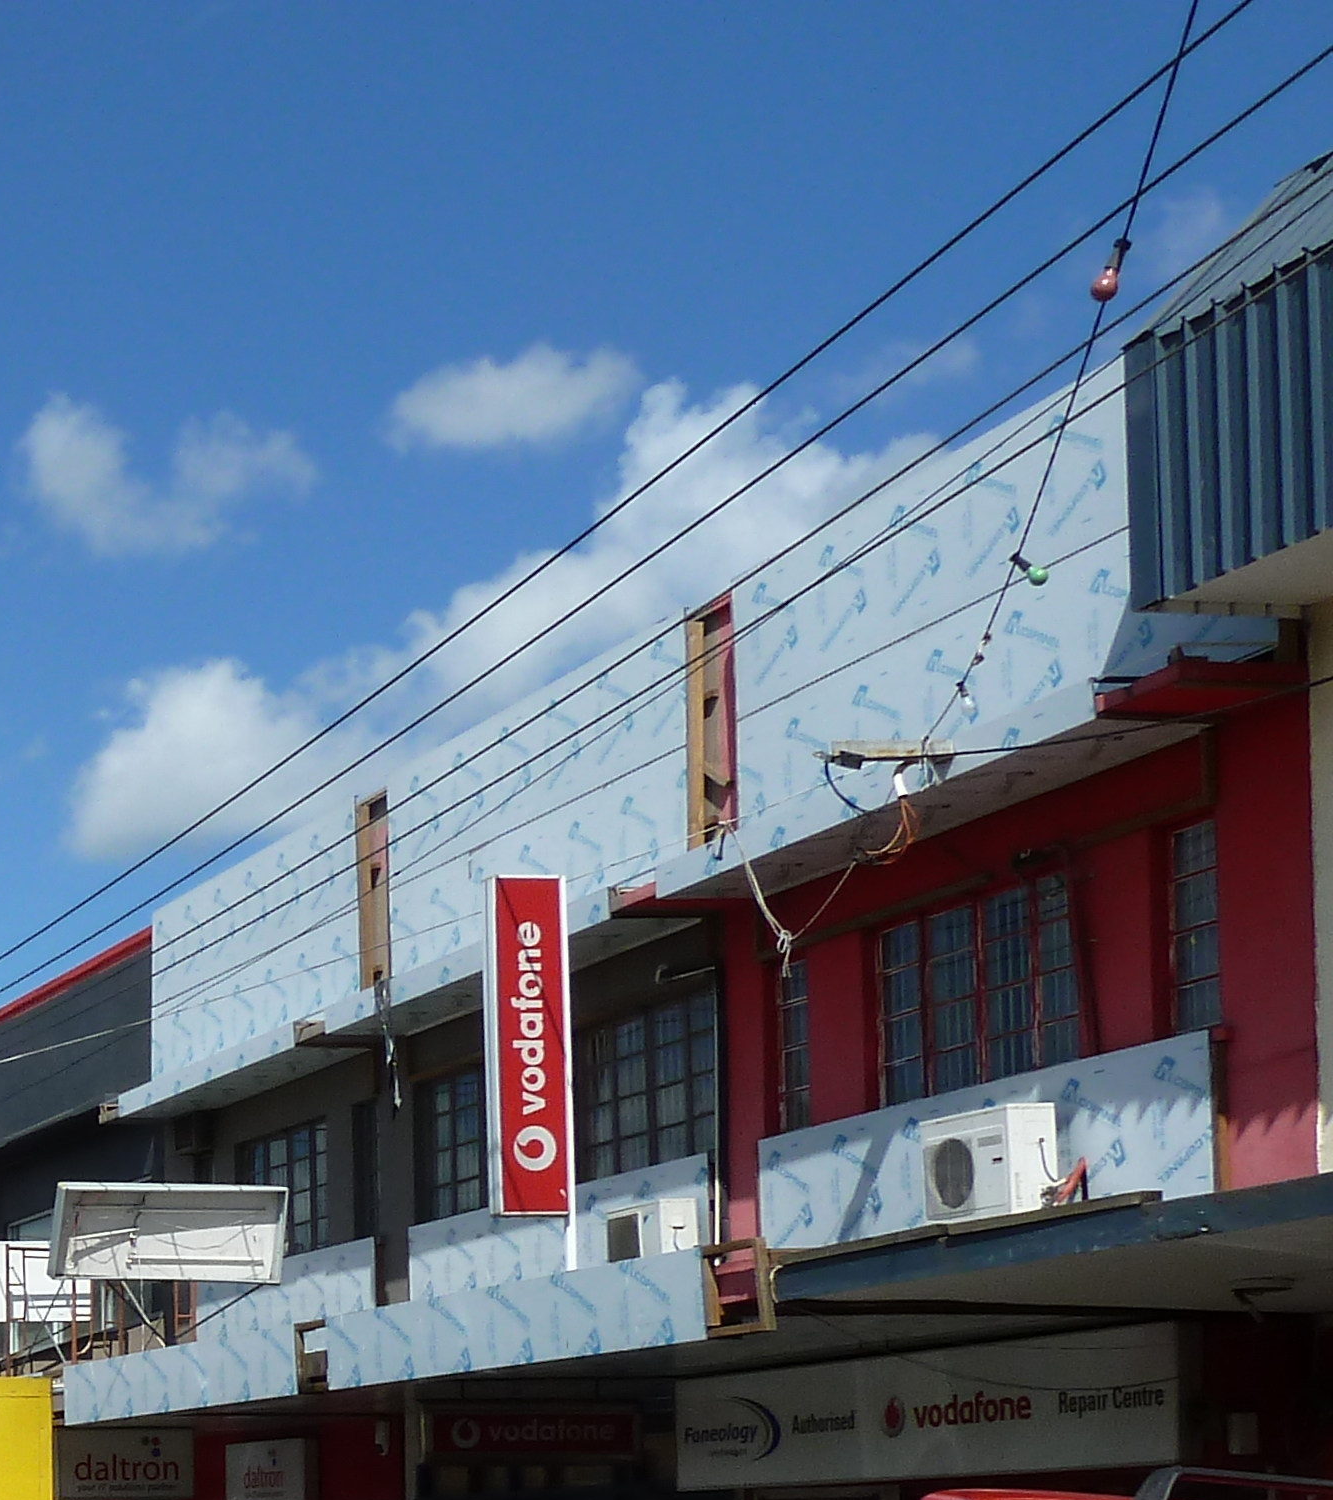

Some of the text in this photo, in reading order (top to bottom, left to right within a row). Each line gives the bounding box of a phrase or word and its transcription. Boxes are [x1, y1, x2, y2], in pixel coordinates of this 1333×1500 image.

[511, 920, 546, 1115] vodafone
[792, 1385, 1165, 1434] Authorised vodafone Repair Centre
[488, 1419, 616, 1441] vodafone
[684, 1422, 758, 1444] Foneology
[75, 1454, 180, 1481] daltron
